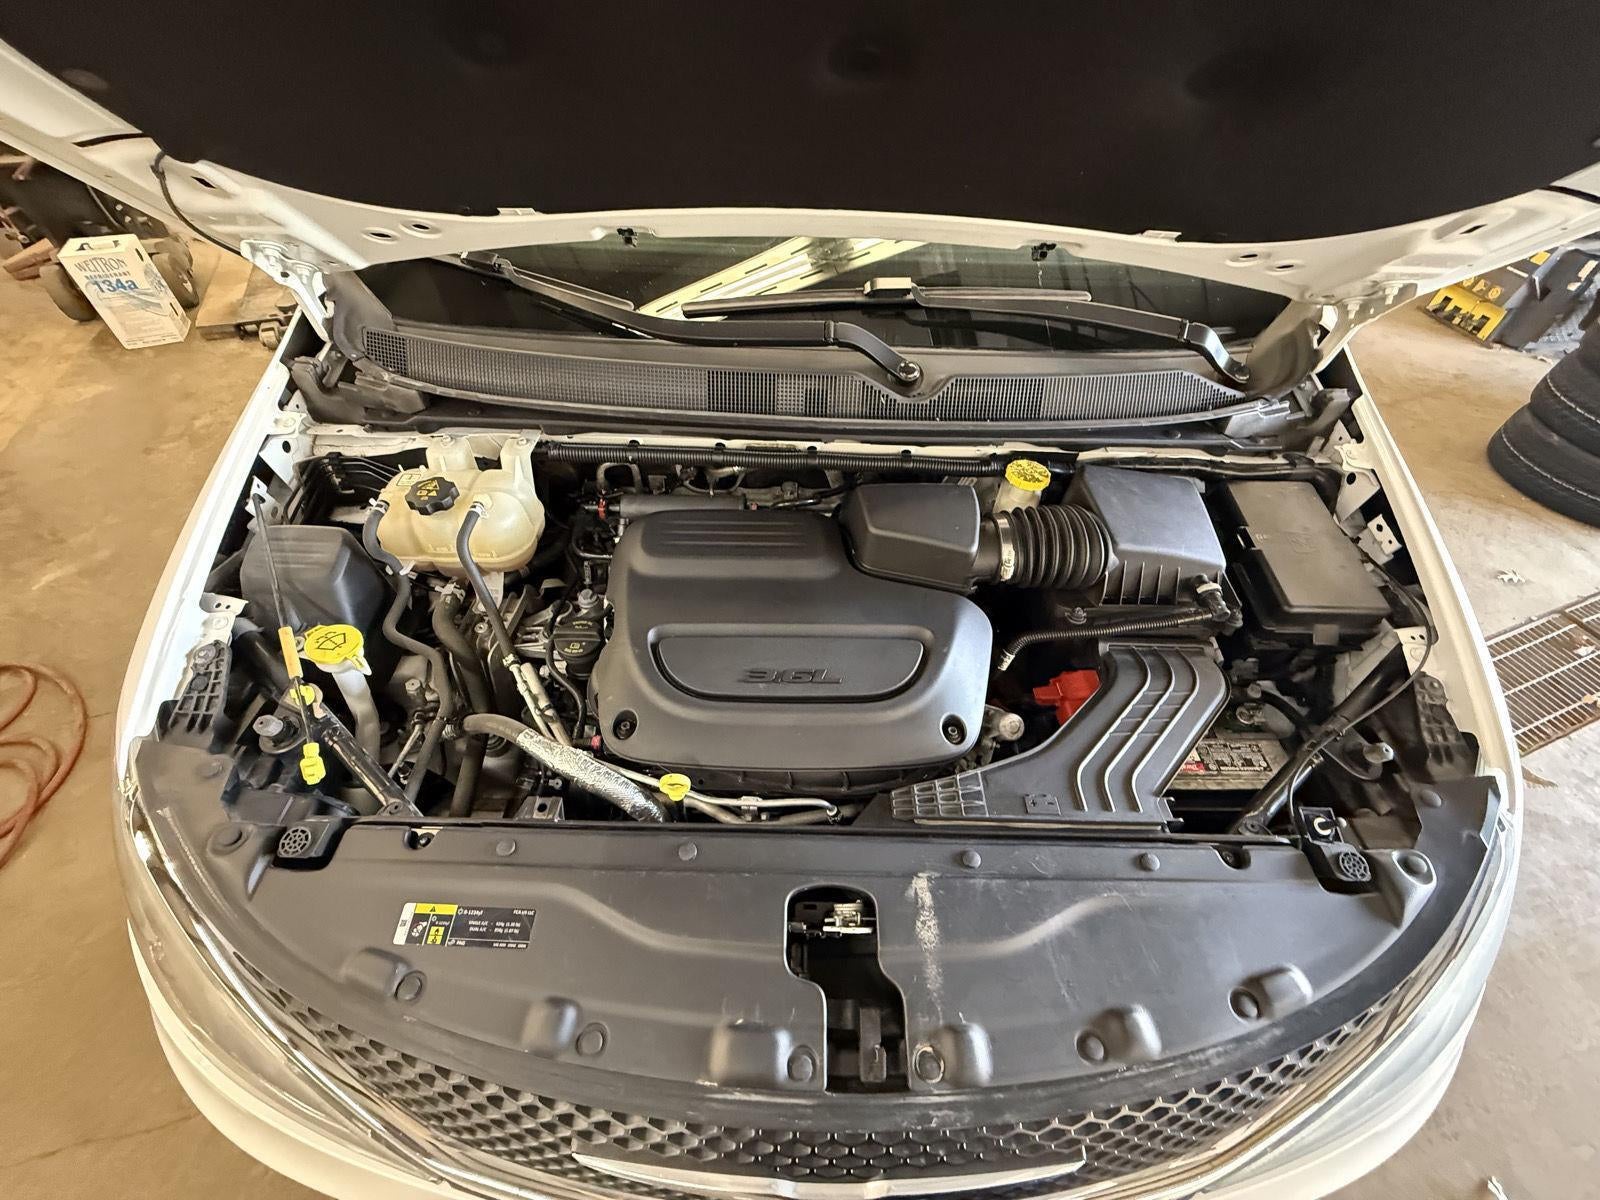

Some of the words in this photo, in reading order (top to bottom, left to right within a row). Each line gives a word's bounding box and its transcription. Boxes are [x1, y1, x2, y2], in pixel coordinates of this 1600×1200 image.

[74, 257, 128, 273] WEITRON
[92, 278, 139, 293] 134a
[738, 668, 842, 685] 3.6L
